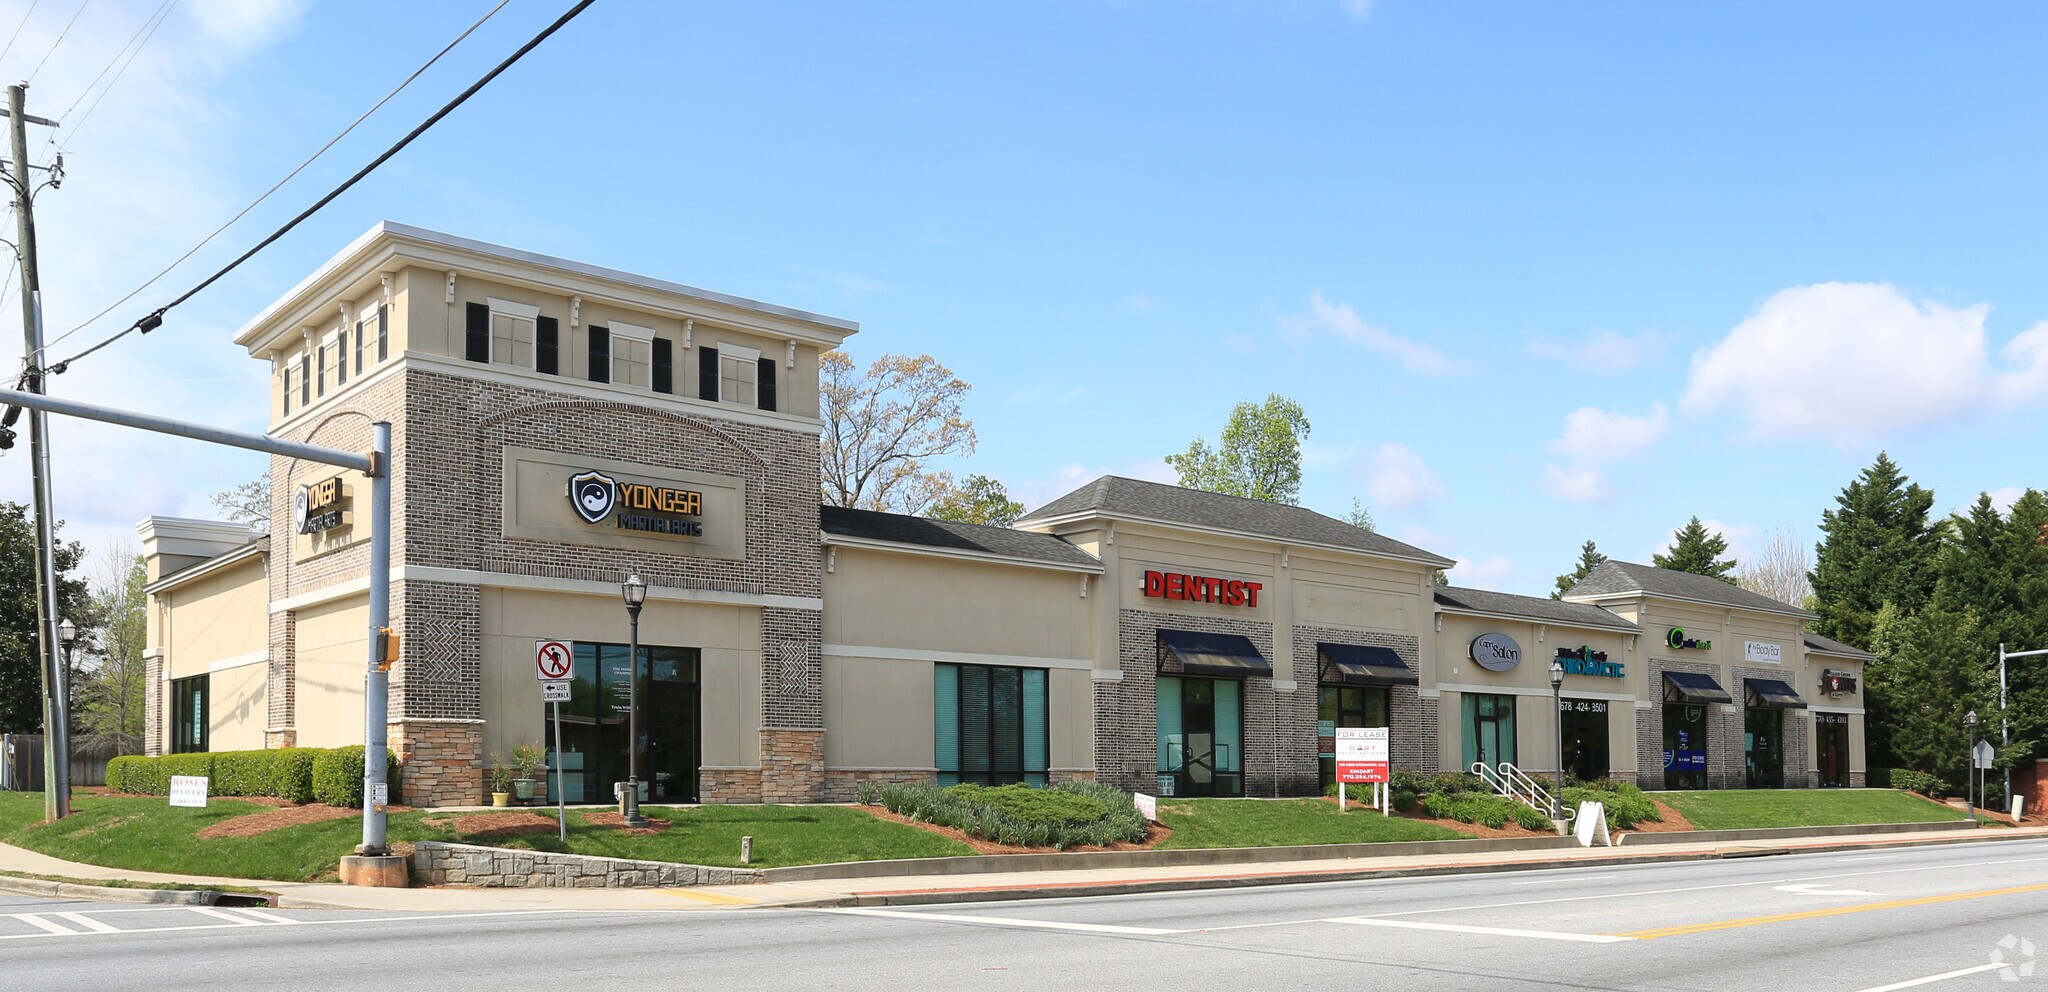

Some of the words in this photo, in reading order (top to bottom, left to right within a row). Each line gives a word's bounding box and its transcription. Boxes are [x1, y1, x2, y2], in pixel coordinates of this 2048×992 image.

[619, 482, 702, 516] YONGSA
[618, 513, 671, 534] MARTIAL
[672, 519, 702, 537] ARTS
[1144, 570, 1262, 608] DENTIST
[1479, 638, 1493, 649] Capri
[1492, 644, 1518, 661] Salon
[543, 692, 569, 700] CROSSWALK
[1560, 701, 1572, 711] 678
[172, 777, 207, 787] ROSES
[171, 788, 205, 796] DELIVERY
